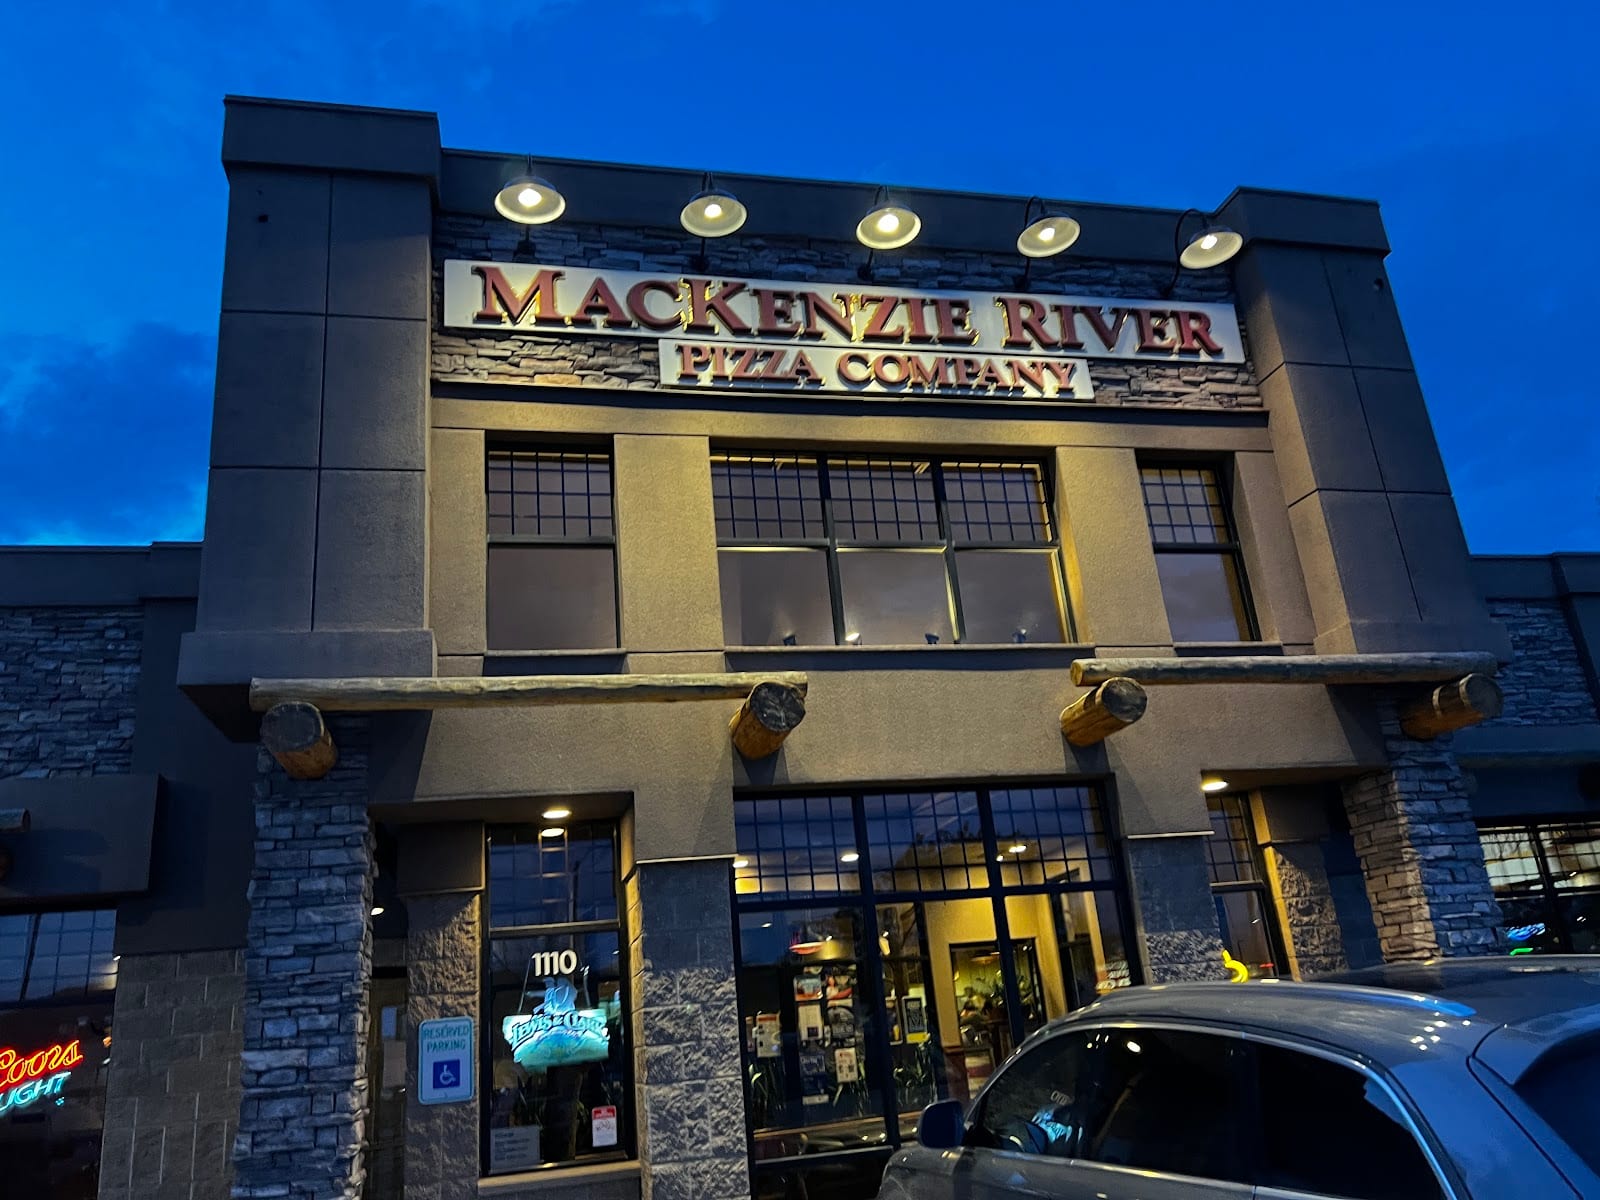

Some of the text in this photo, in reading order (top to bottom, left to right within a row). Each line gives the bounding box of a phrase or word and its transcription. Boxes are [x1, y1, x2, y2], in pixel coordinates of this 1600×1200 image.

[471, 265, 1223, 357] MACKENZIE RIVER
[674, 343, 1078, 397] PIZZA COMPANY
[532, 949, 578, 977] 1110
[423, 1023, 470, 1039] RESERVED
[426, 1039, 467, 1053] PARKING
